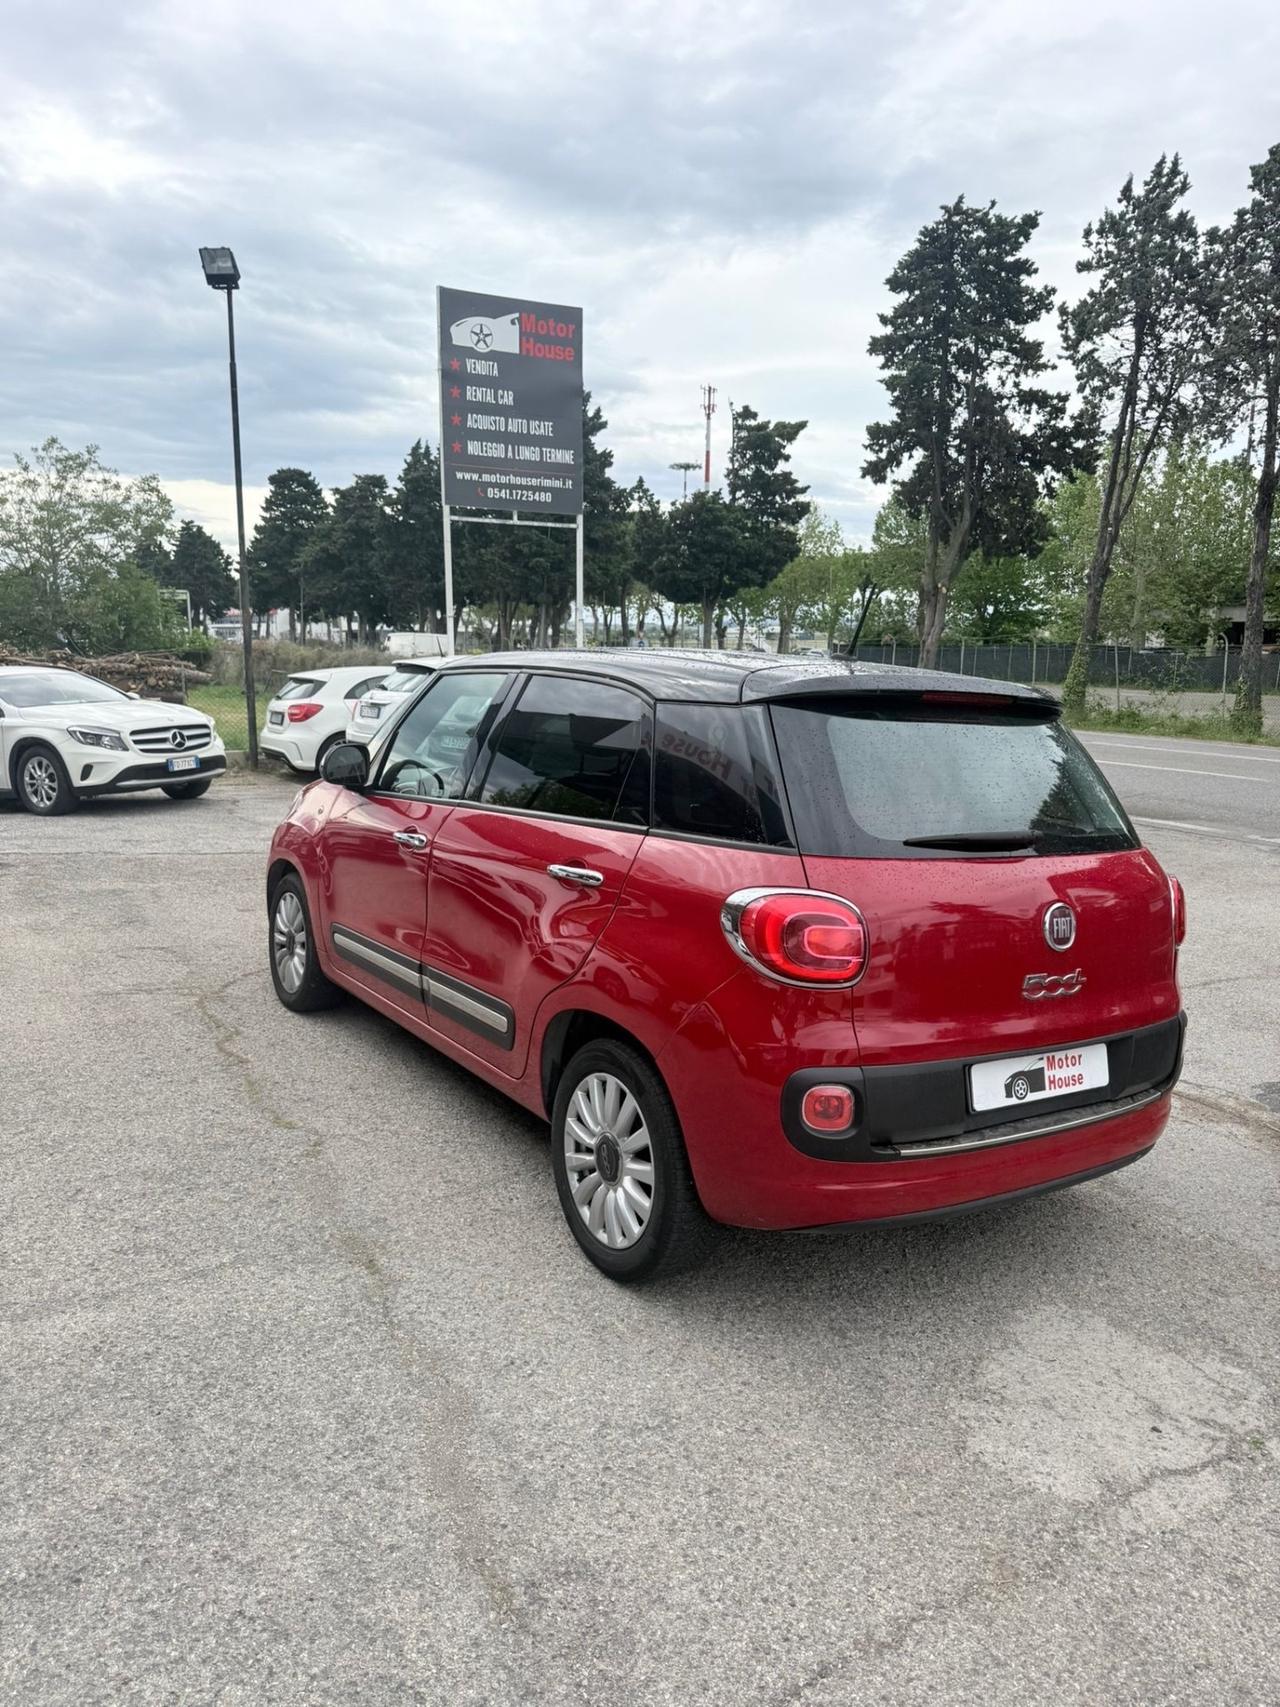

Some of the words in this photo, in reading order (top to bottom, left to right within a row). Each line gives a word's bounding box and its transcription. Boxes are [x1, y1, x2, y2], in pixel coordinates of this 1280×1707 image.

[521, 311, 576, 339] Motor
[521, 337, 575, 362] House
[465, 358, 499, 377] VENDITA
[466, 386, 496, 404] RENTAL
[497, 389, 514, 406] CAR
[467, 413, 506, 432] ACQUISTO
[507, 418, 528, 434] AUTO
[529, 421, 554, 437] USATE
[467, 440, 505, 459] NOLEGGIO
[507, 444, 513, 460] A
[514, 445, 541, 462] LUNGO
[542, 448, 575, 465] TERMINE
[455, 471, 573, 490] www.motorhouserimini.it
[487, 487, 552, 503] 0541.1725480
[1053, 917, 1071, 939] FIAT
[1046, 1053, 1083, 1071] Motor
[1048, 1073, 1084, 1091] House
